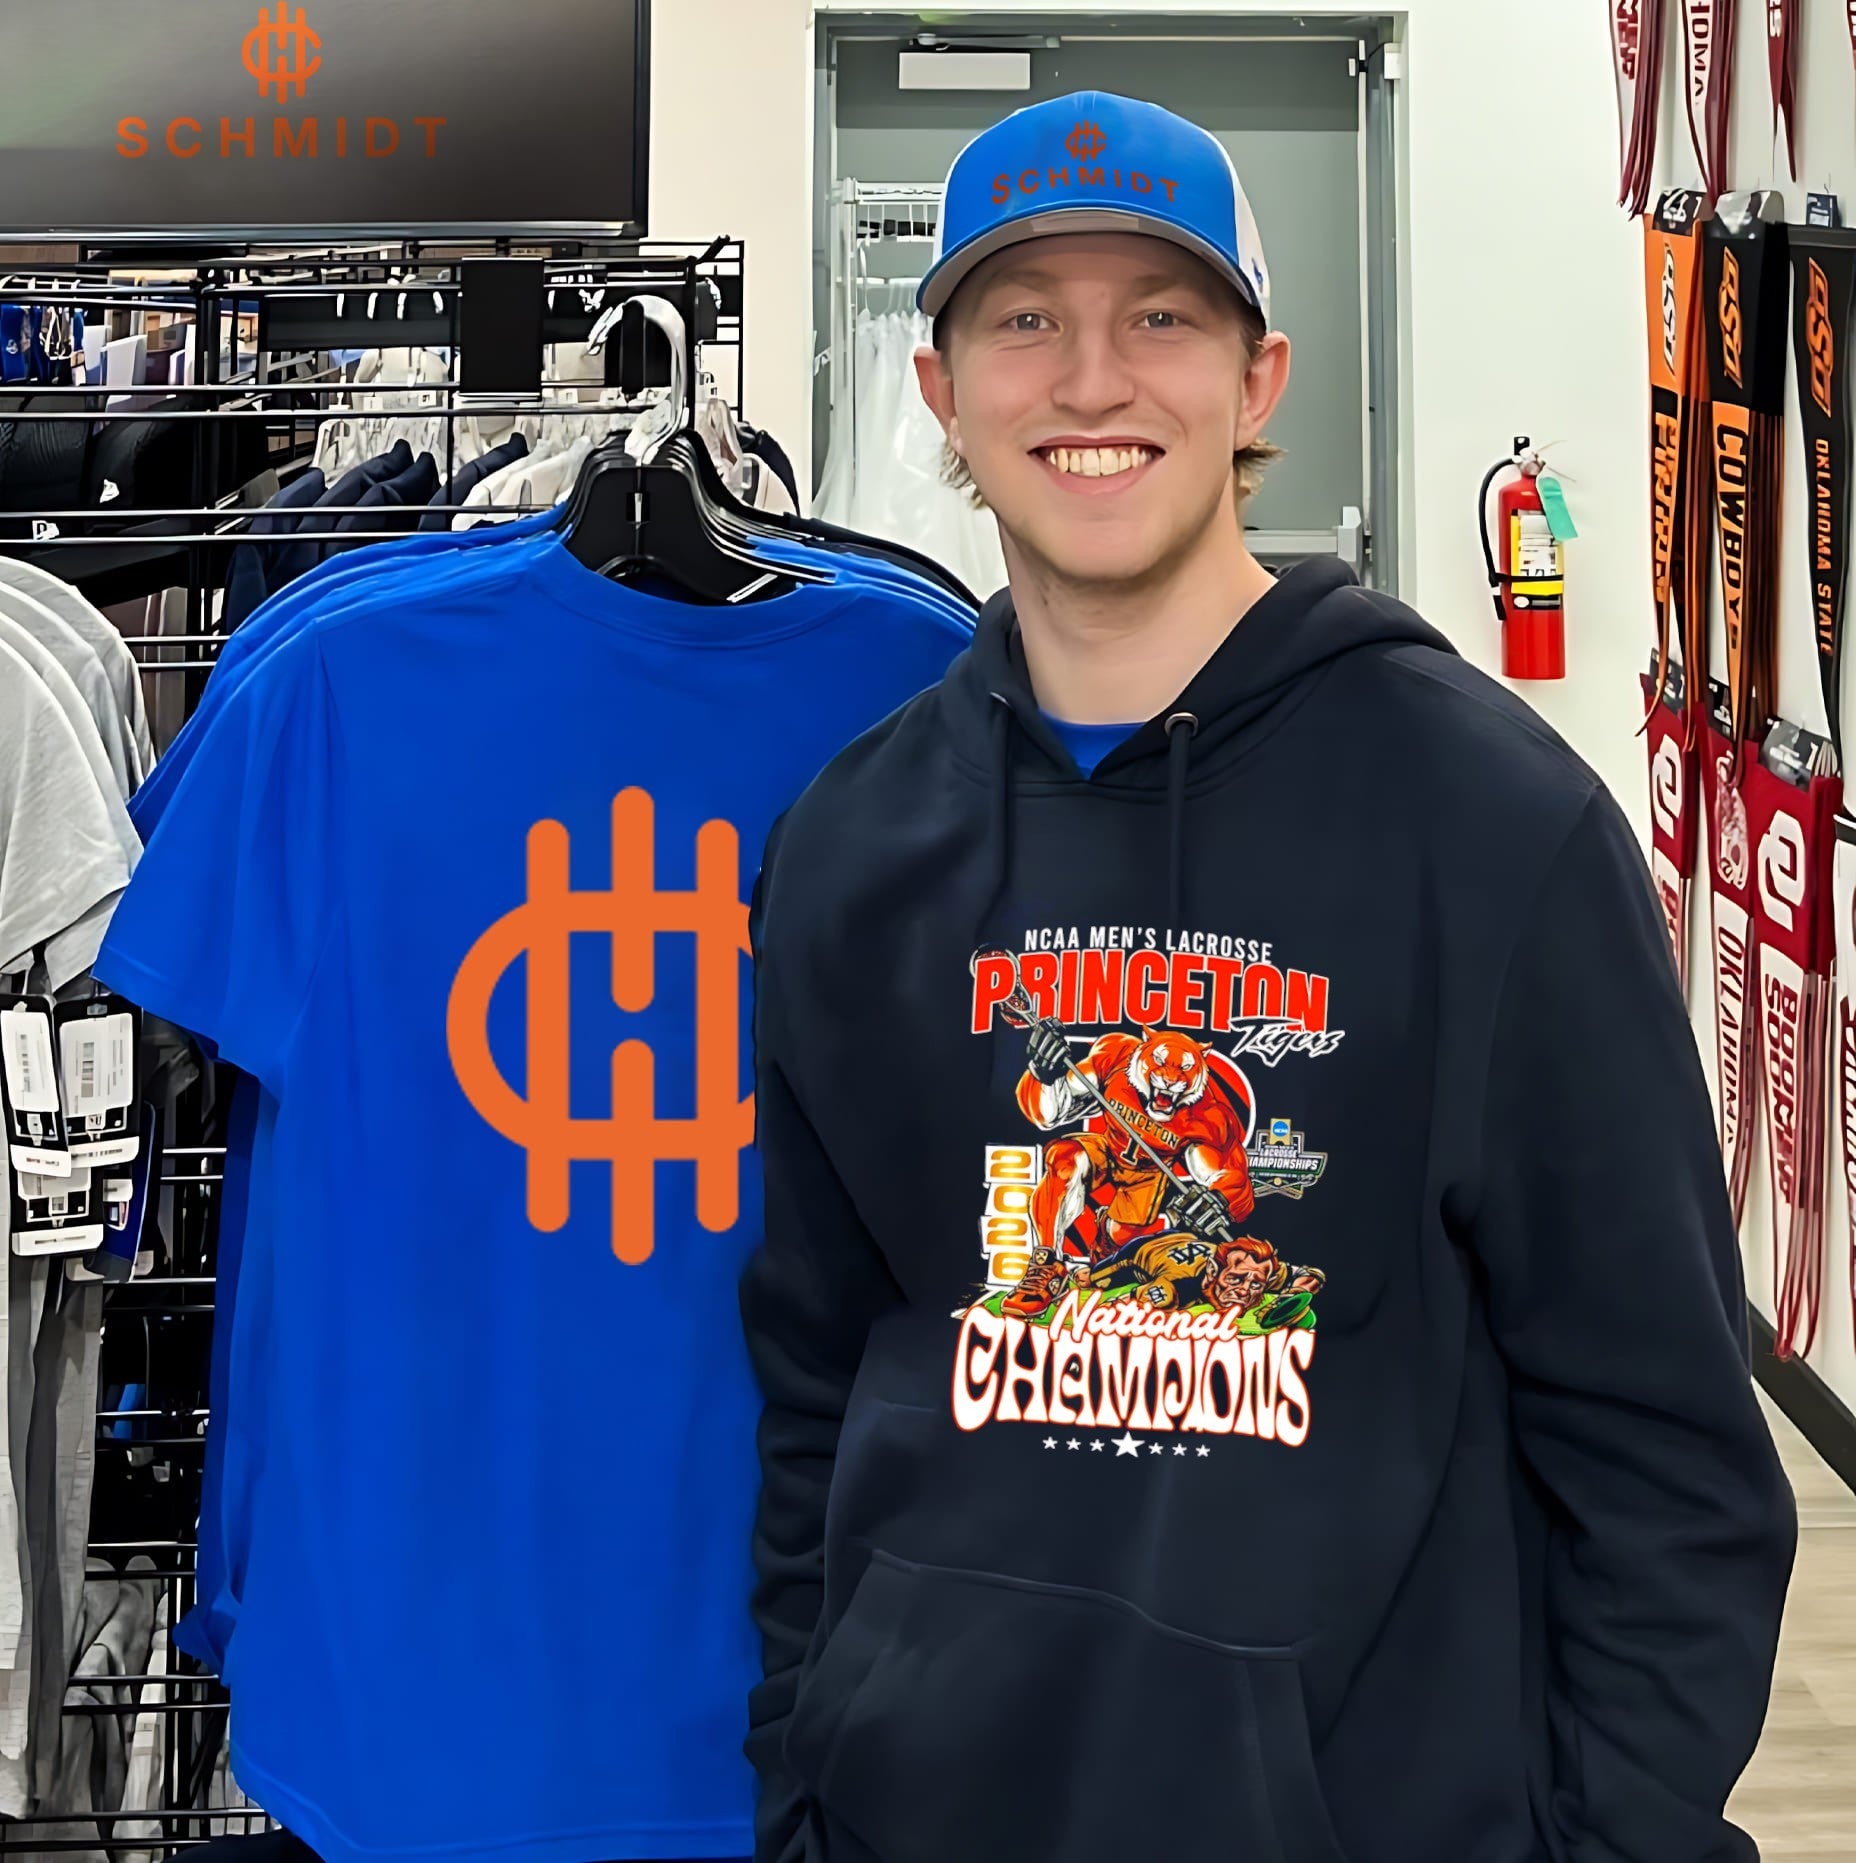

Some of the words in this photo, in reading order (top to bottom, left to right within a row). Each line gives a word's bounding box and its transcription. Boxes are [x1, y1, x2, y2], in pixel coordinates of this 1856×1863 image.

[116, 116, 447, 159] SCHMIDT
[991, 167, 1179, 204] SCHMIDT
[1024, 928, 1079, 951] NCAA
[1089, 925, 1157, 950] MEN'S
[1165, 928, 1273, 965] LACROSSE
[971, 948, 1331, 1034] PRINCETON
[1228, 1015, 1346, 1068] Tigers
[1248, 1156, 1319, 1171] AMPIONSHIPS
[1259, 1147, 1298, 1159] LACROSSE
[1048, 1288, 1243, 1343] National
[950, 1305, 1317, 1448] CHAMPIONS
